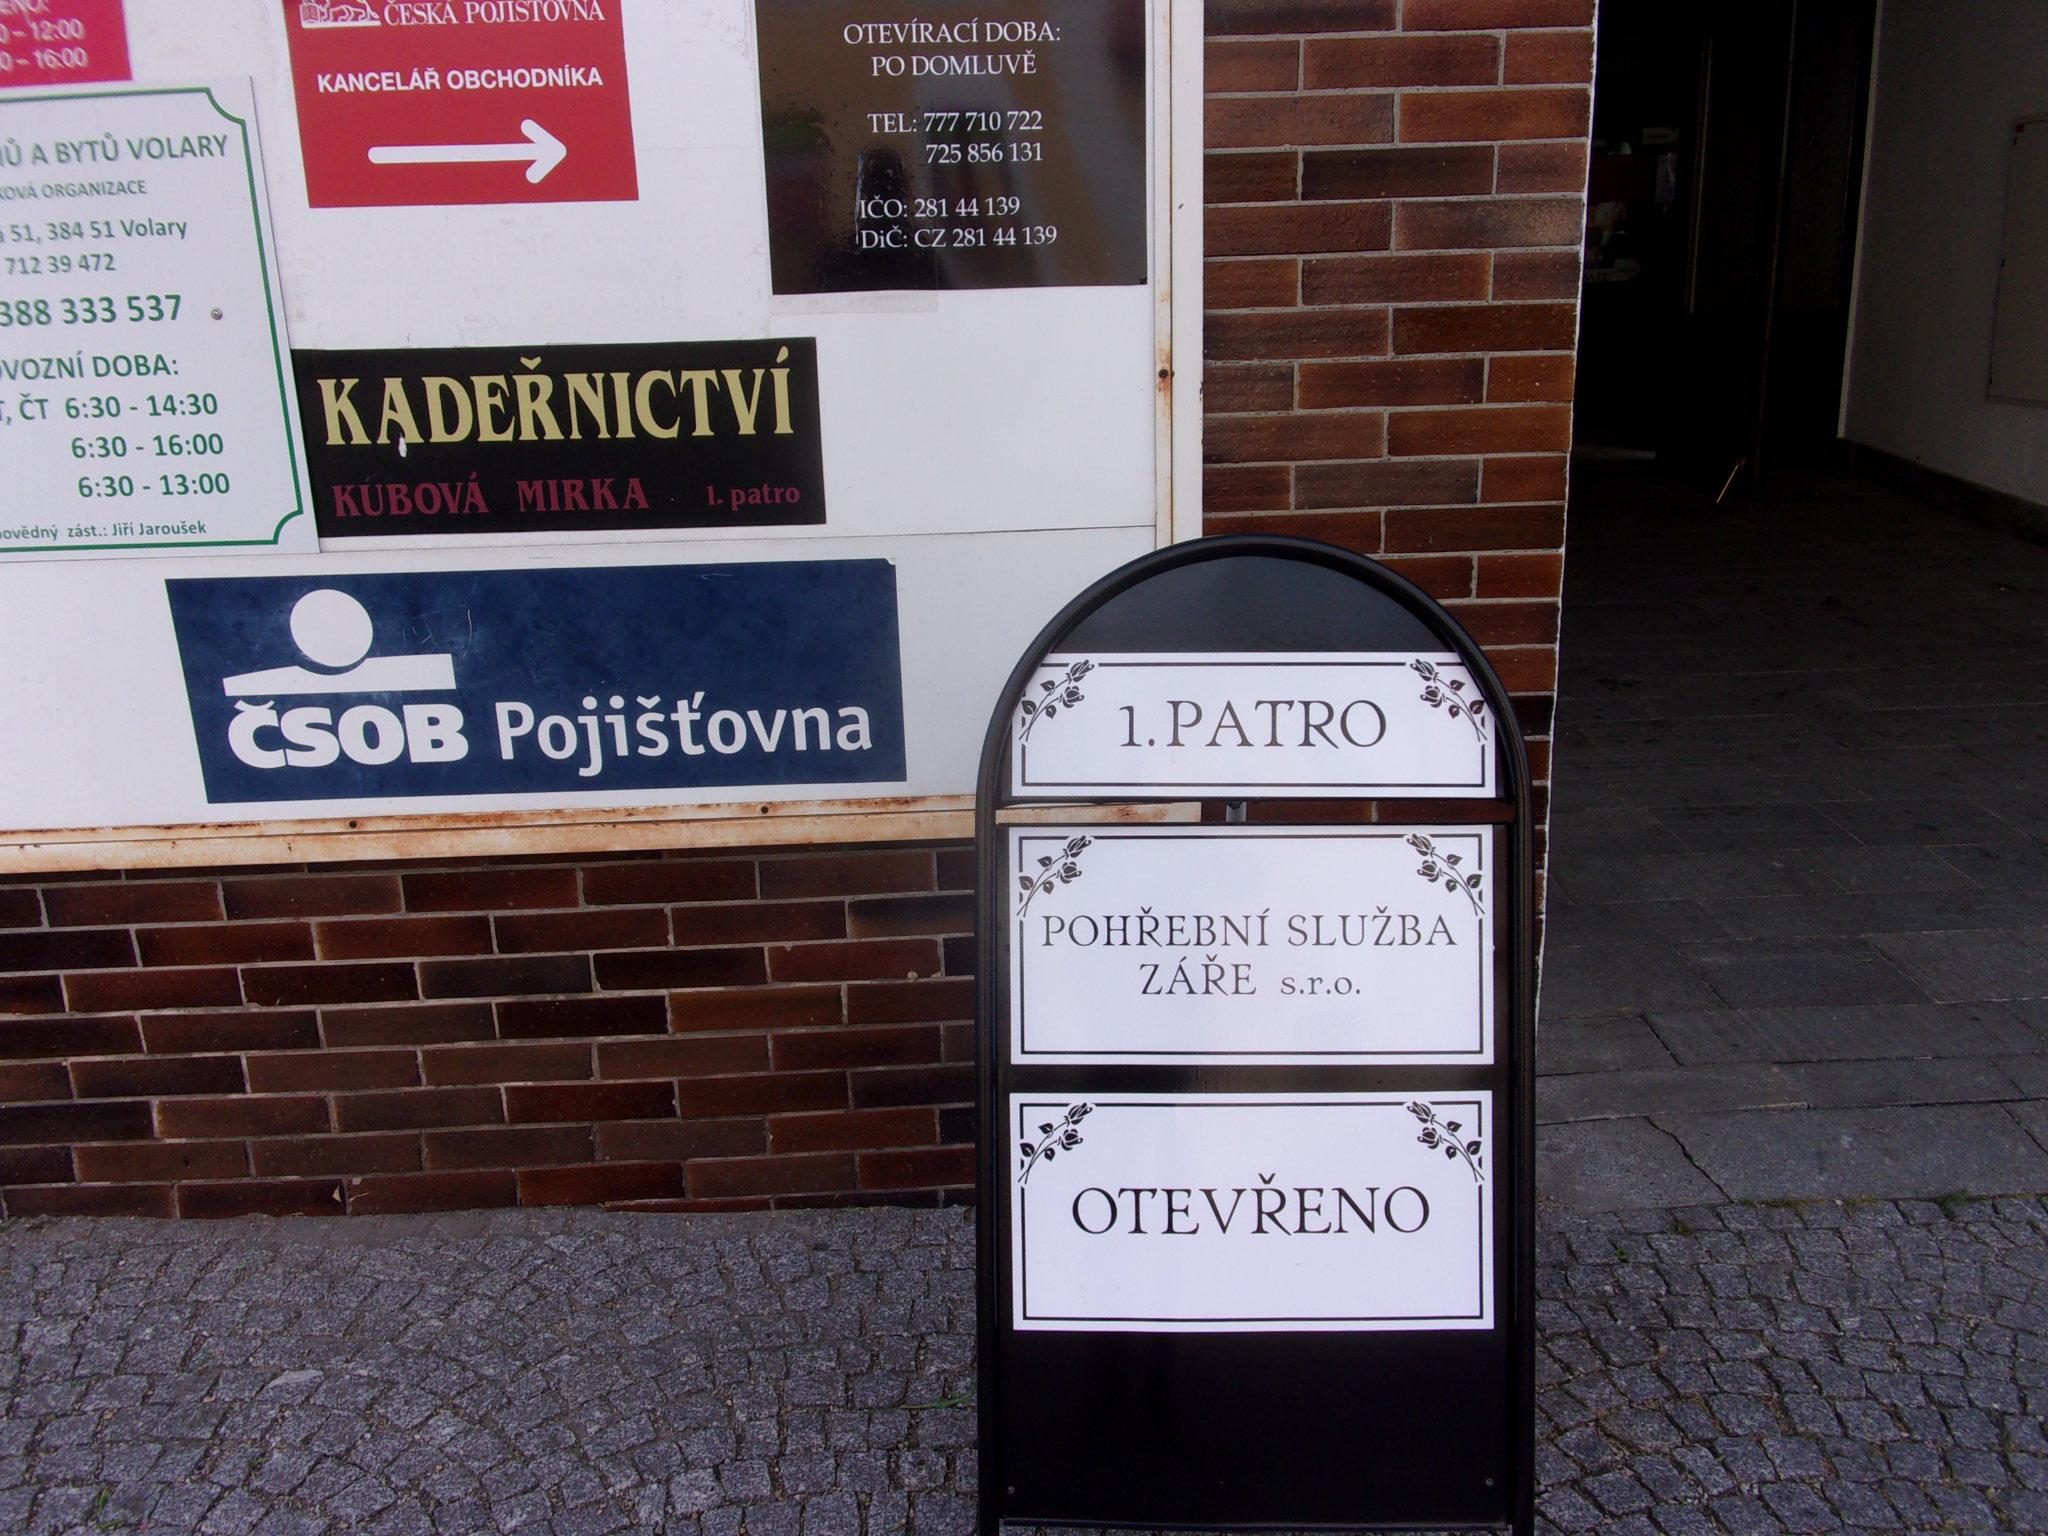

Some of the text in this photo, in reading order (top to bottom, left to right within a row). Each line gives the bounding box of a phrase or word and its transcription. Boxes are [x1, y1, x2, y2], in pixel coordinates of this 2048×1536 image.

[28, 18, 87, 41] 12:00
[843, 17, 1061, 45] OTEVÍRACÍ DOBA:
[33, 46, 89, 71] 16:00
[871, 49, 1037, 77] PO DOMLUVĚ
[317, 66, 603, 93] KANCELÁŘ OBCHODNÍKA
[867, 110, 1043, 133] TEL: 777 710 722
[31, 142, 49, 165] A
[55, 131, 118, 164] BYTŮ
[127, 134, 228, 160] VOLARY
[926, 142, 1043, 164] 725 856 131
[42, 179, 147, 199] ORGANIZACE
[860, 195, 1020, 219] IČO: 281 44 139
[9, 223, 41, 245] 51,
[47, 222, 84, 241] 384
[89, 219, 115, 239] 51
[121, 218, 187, 239] Volary
[914, 228, 946, 248] CZ
[952, 227, 986, 247] 281
[993, 226, 1017, 246] 44
[1023, 225, 1057, 245] 139
[4, 252, 116, 275] 712 39 472
[62, 296, 117, 324] 333
[127, 294, 182, 321] 537
[93, 354, 179, 378] DOBA:
[19, 392, 49, 420] ČT
[65, 396, 121, 419] 6:30
[147, 393, 218, 416] 14:30
[317, 345, 794, 446] KADEŘNICTVÍ
[71, 436, 127, 459] 6:30
[153, 433, 224, 456] 16:00
[78, 475, 134, 498] 6:30
[160, 472, 230, 495] 13:00
[332, 472, 800, 517] KUBOVÁ MIRKA 1. patro
[0, 524, 58, 541] ovědný
[112, 522, 134, 536] Jiří
[139, 520, 207, 535] Jaroušek
[227, 692, 872, 778] ČSOB Pojišťovna
[1041, 905, 1458, 947] POHŘEBNÍ SLUŽBA
[1140, 954, 1361, 996] ZÁŘE s.r.o.
[1072, 1173, 1430, 1236] OTEVŘENO
